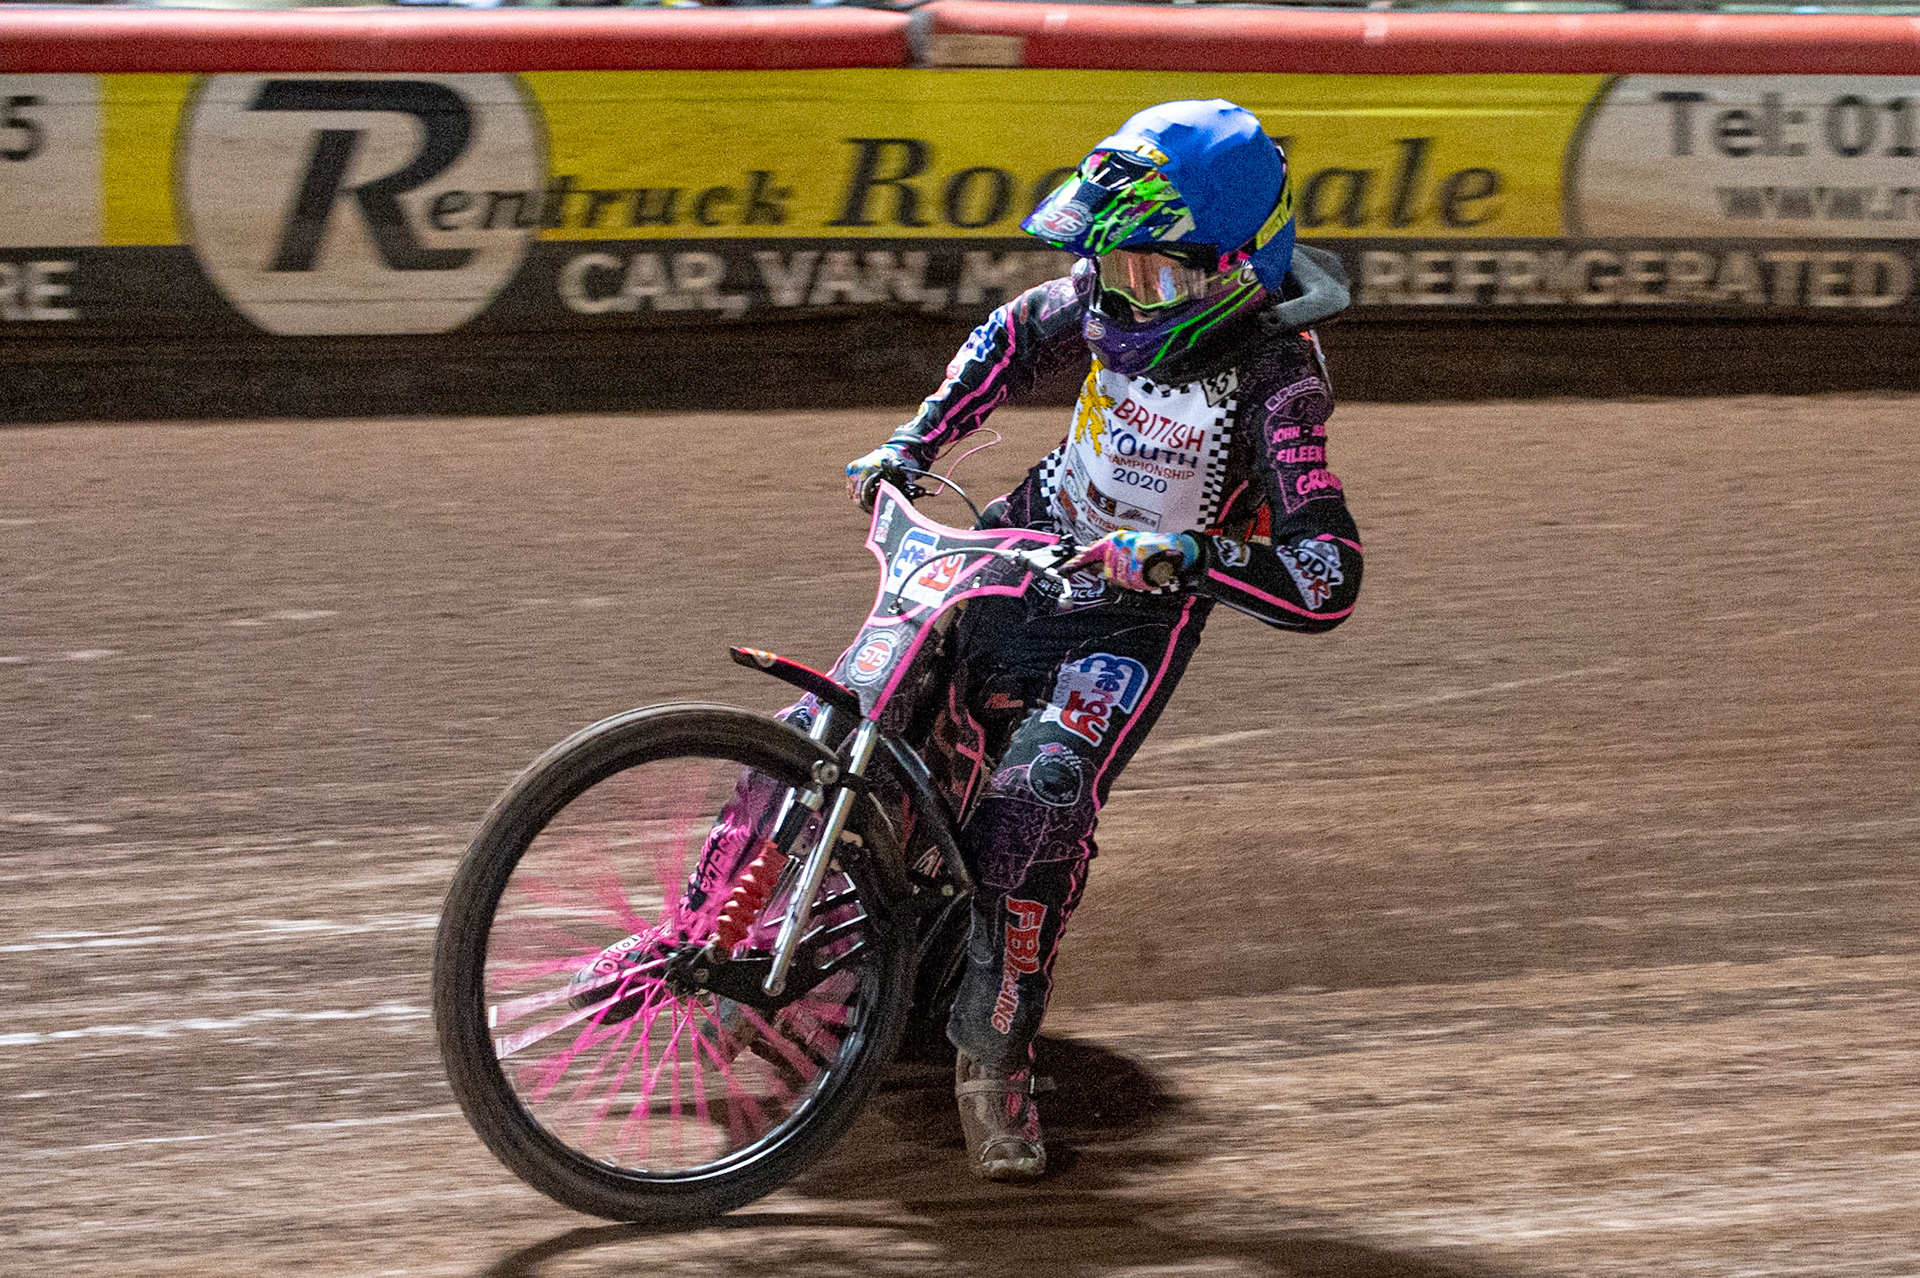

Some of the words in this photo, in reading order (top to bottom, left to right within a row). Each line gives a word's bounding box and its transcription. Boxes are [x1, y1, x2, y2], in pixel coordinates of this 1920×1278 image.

[823, 135, 1504, 230] Rocale
[1107, 418, 1198, 468] YOUTH
[1113, 397, 1205, 452] BRITISH
[1112, 467, 1167, 493] 2020
[856, 645, 892, 668] STS
